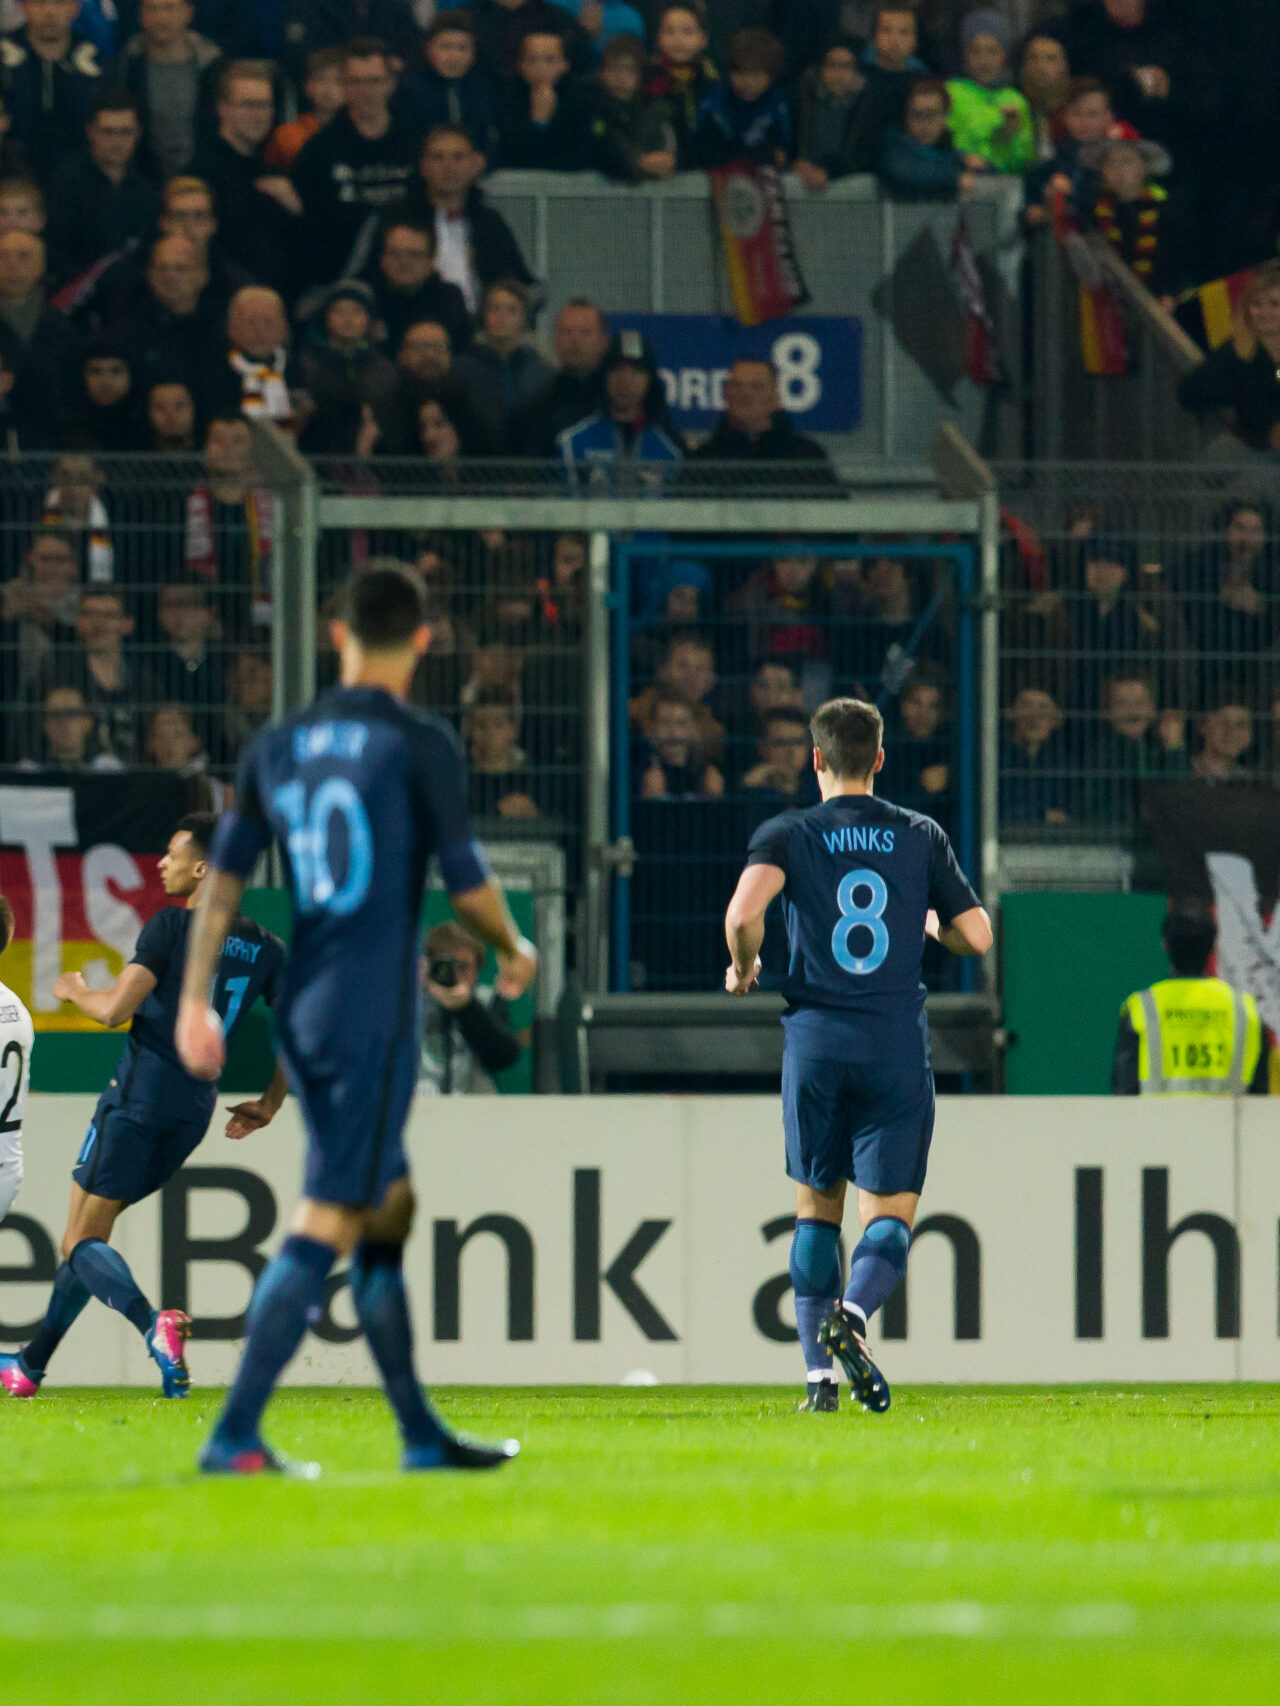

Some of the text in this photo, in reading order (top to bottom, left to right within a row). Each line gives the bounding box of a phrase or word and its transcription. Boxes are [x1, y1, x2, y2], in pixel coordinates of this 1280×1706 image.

[772, 332, 822, 413] 8
[272, 776, 375, 916] 10
[822, 826, 895, 855] WINKS
[218, 935, 263, 964] RPHY
[831, 868, 890, 975] 8
[1074, 1166, 1280, 1340] Ih
